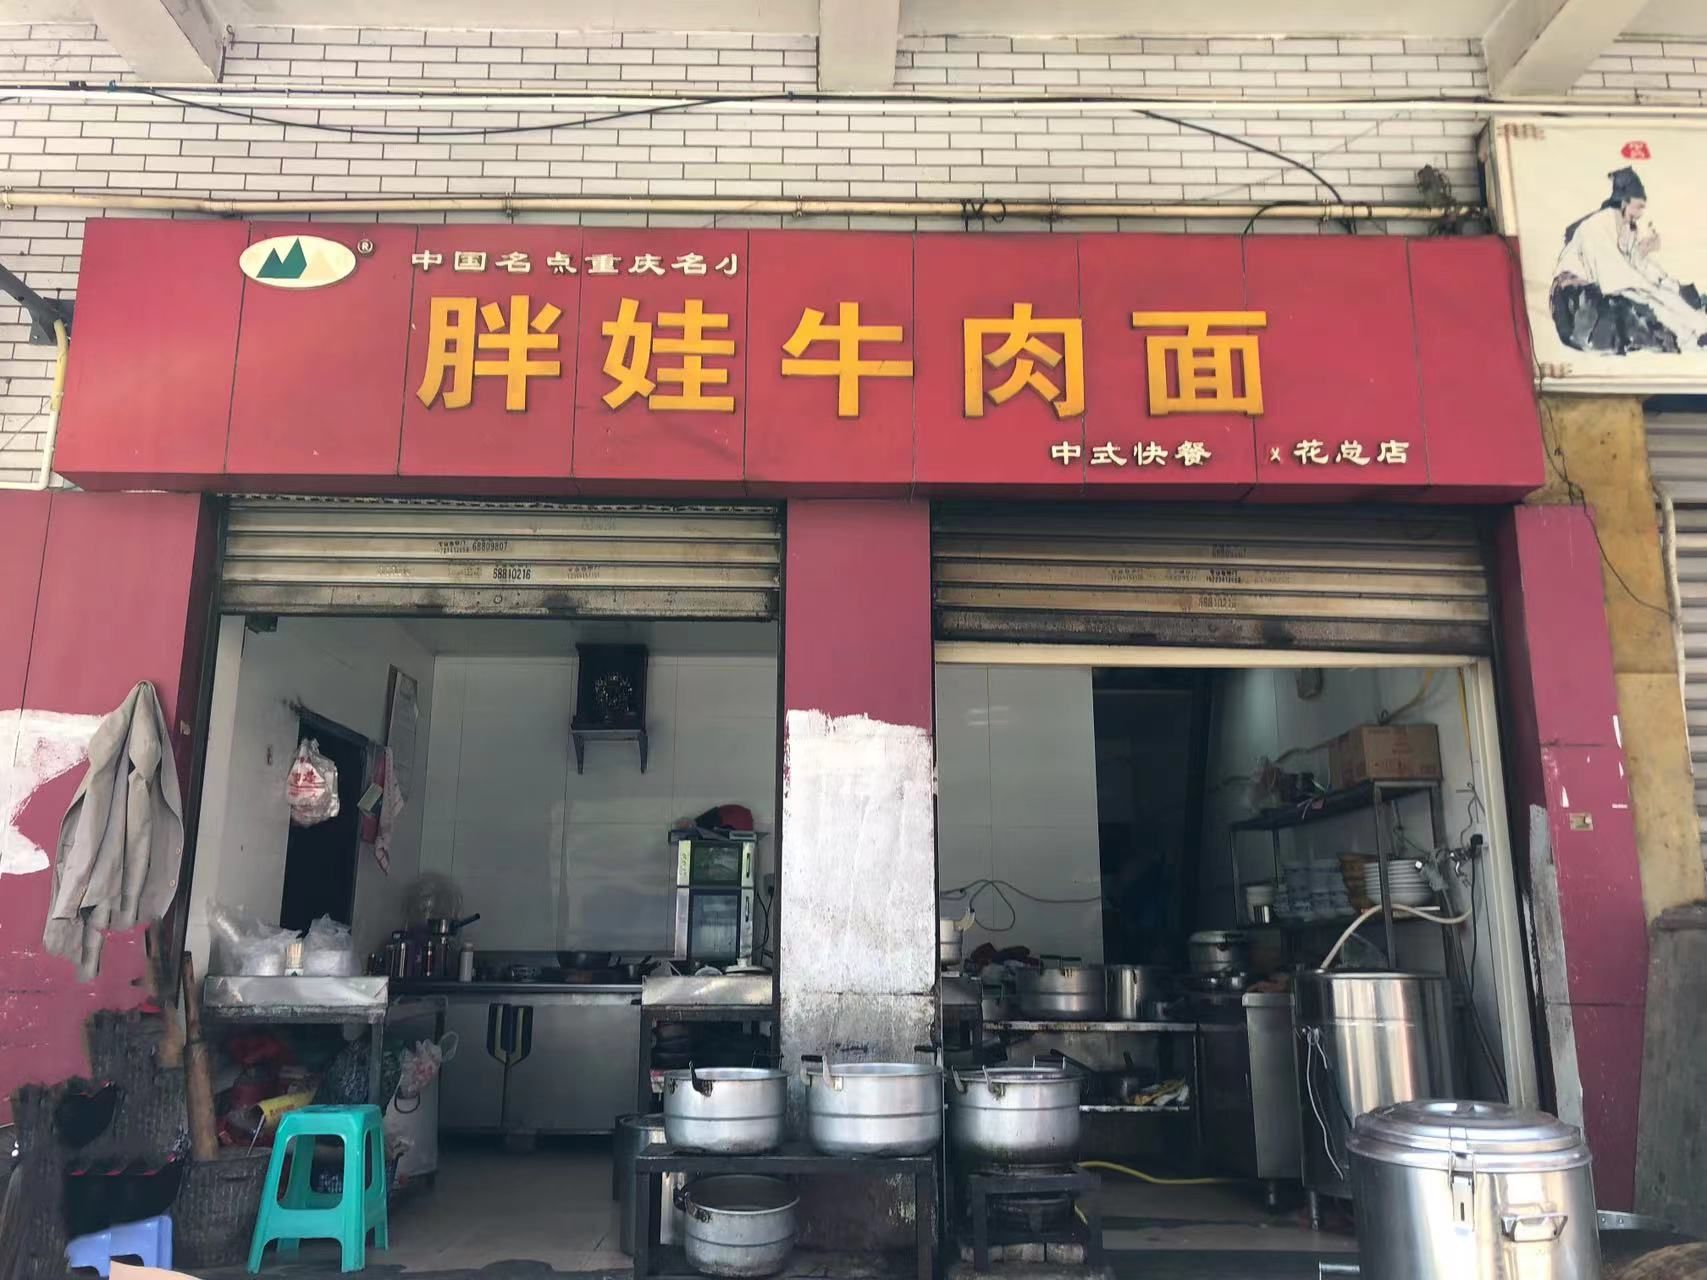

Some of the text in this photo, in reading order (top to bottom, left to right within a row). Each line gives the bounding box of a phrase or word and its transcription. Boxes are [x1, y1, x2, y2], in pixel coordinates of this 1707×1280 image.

[417, 294, 1268, 419] 胖娃牛肉面
[1051, 440, 1212, 467] 中式快餐
